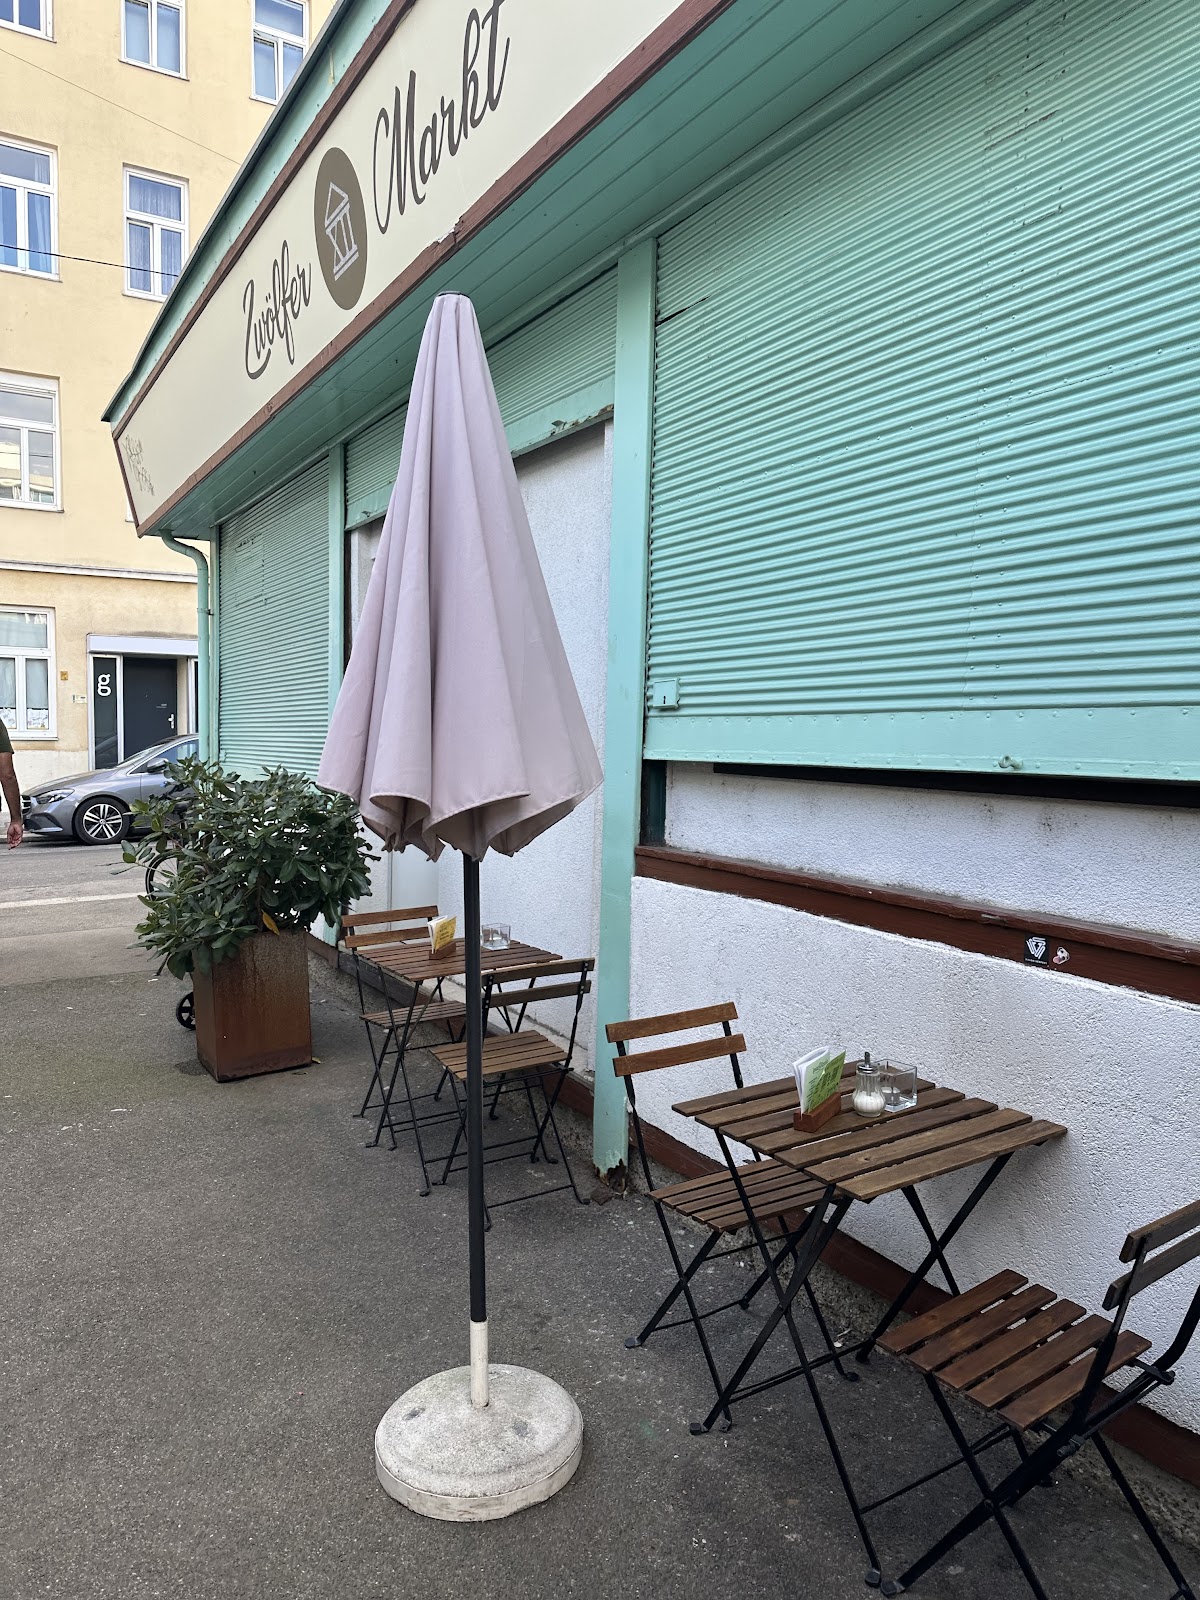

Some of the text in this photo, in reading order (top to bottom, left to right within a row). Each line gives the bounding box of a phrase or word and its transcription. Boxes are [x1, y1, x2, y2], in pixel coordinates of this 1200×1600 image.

[243, 0, 510, 379] Zwölfer Markt
[97, 673, 112, 697] g
